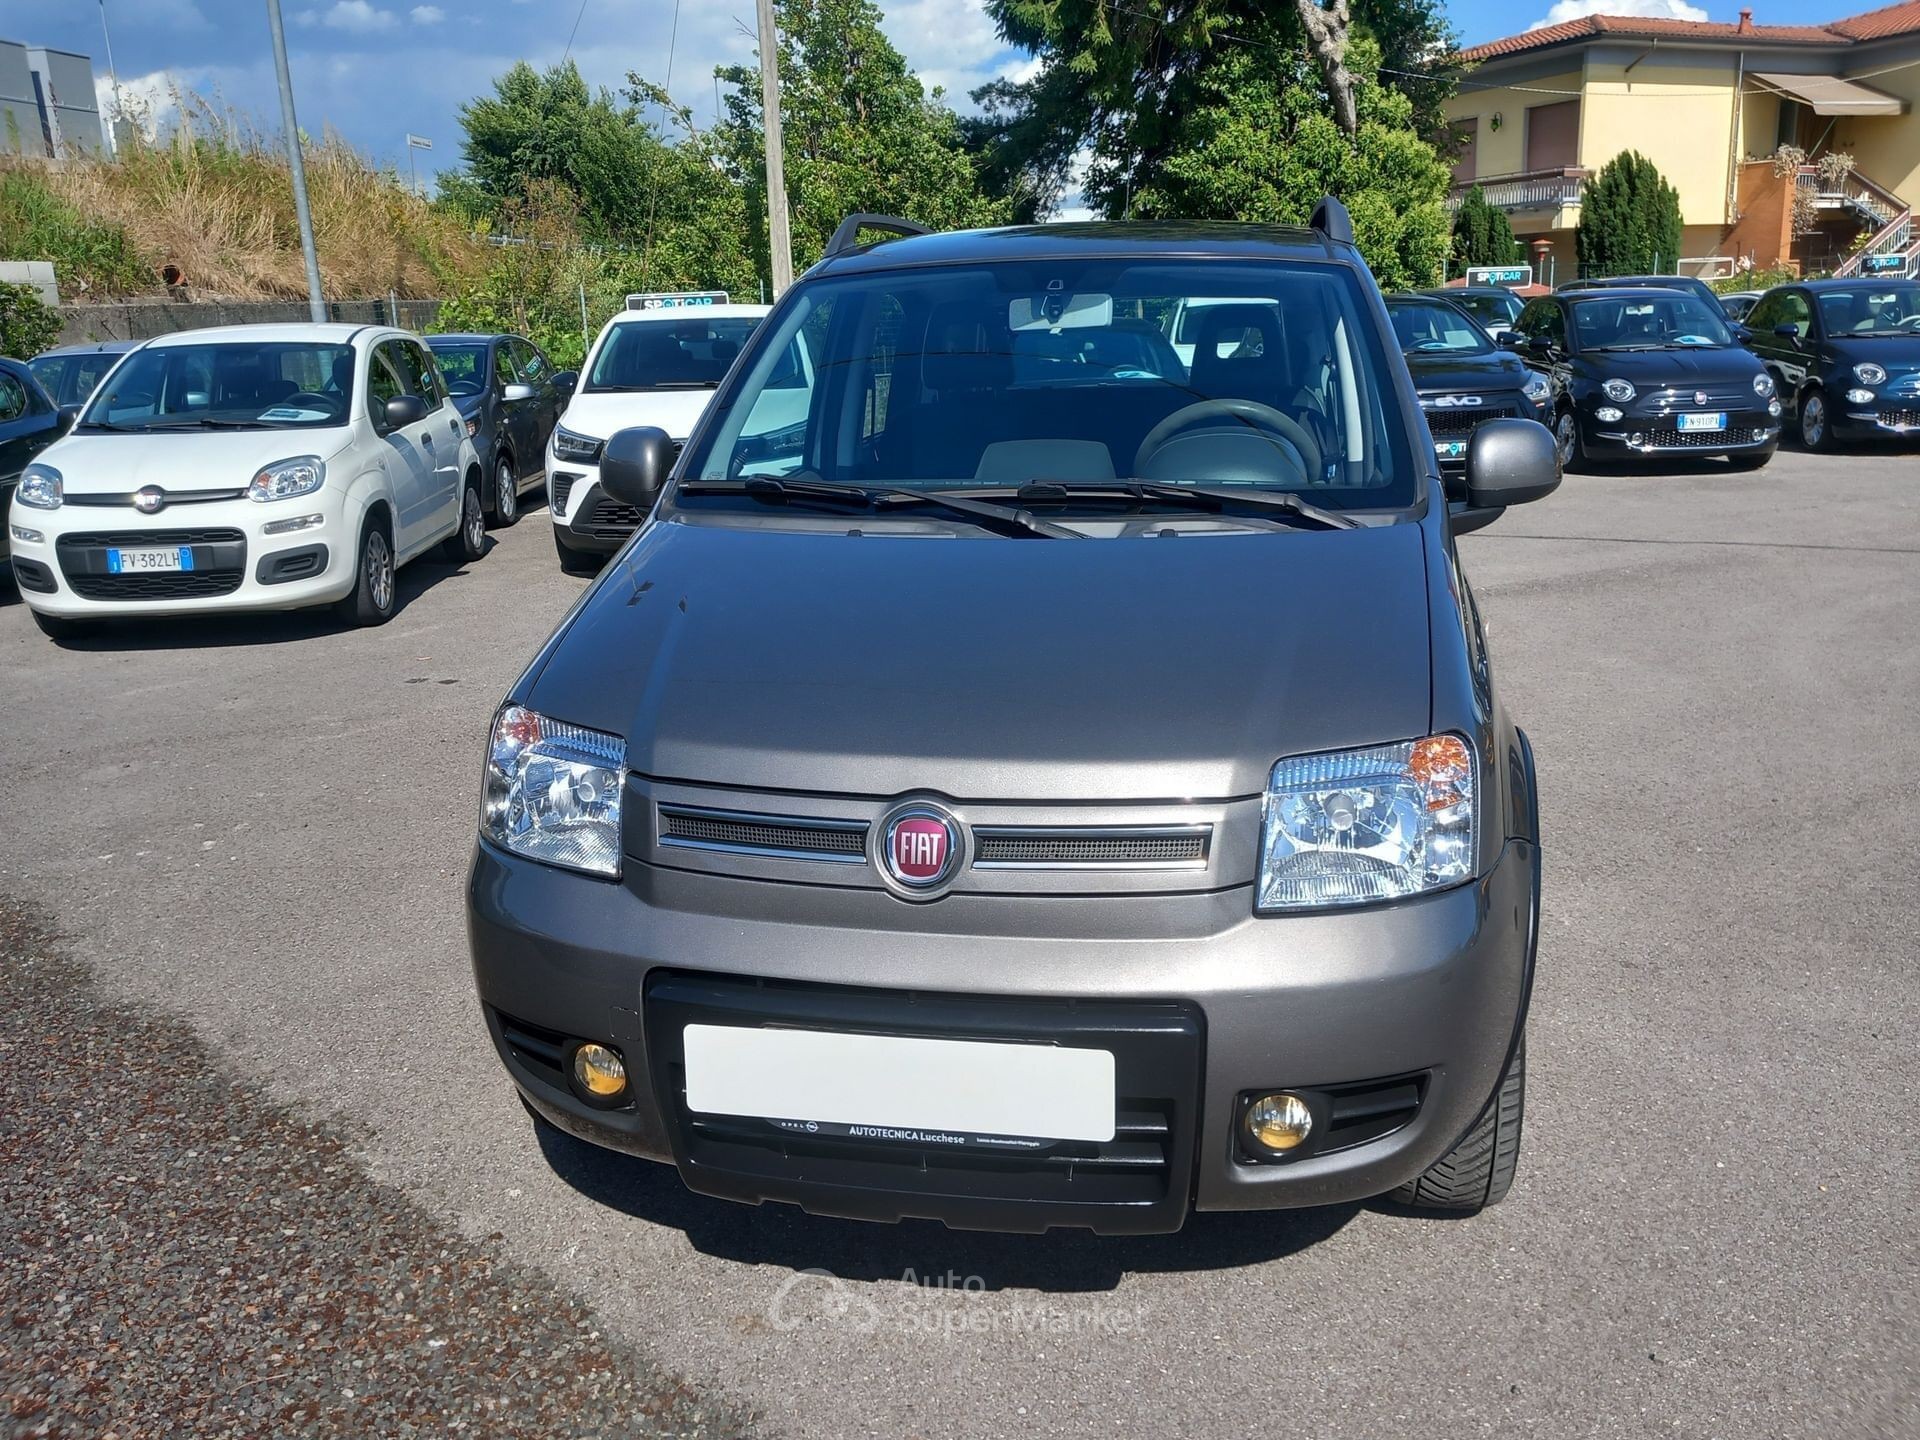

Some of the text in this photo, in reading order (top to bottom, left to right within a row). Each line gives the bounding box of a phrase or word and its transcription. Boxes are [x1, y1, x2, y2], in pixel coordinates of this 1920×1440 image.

[899, 831, 943, 866] FIAT
[849, 1125, 919, 1141] AUTOTECNICA
[920, 1131, 965, 1144] Lucchese
